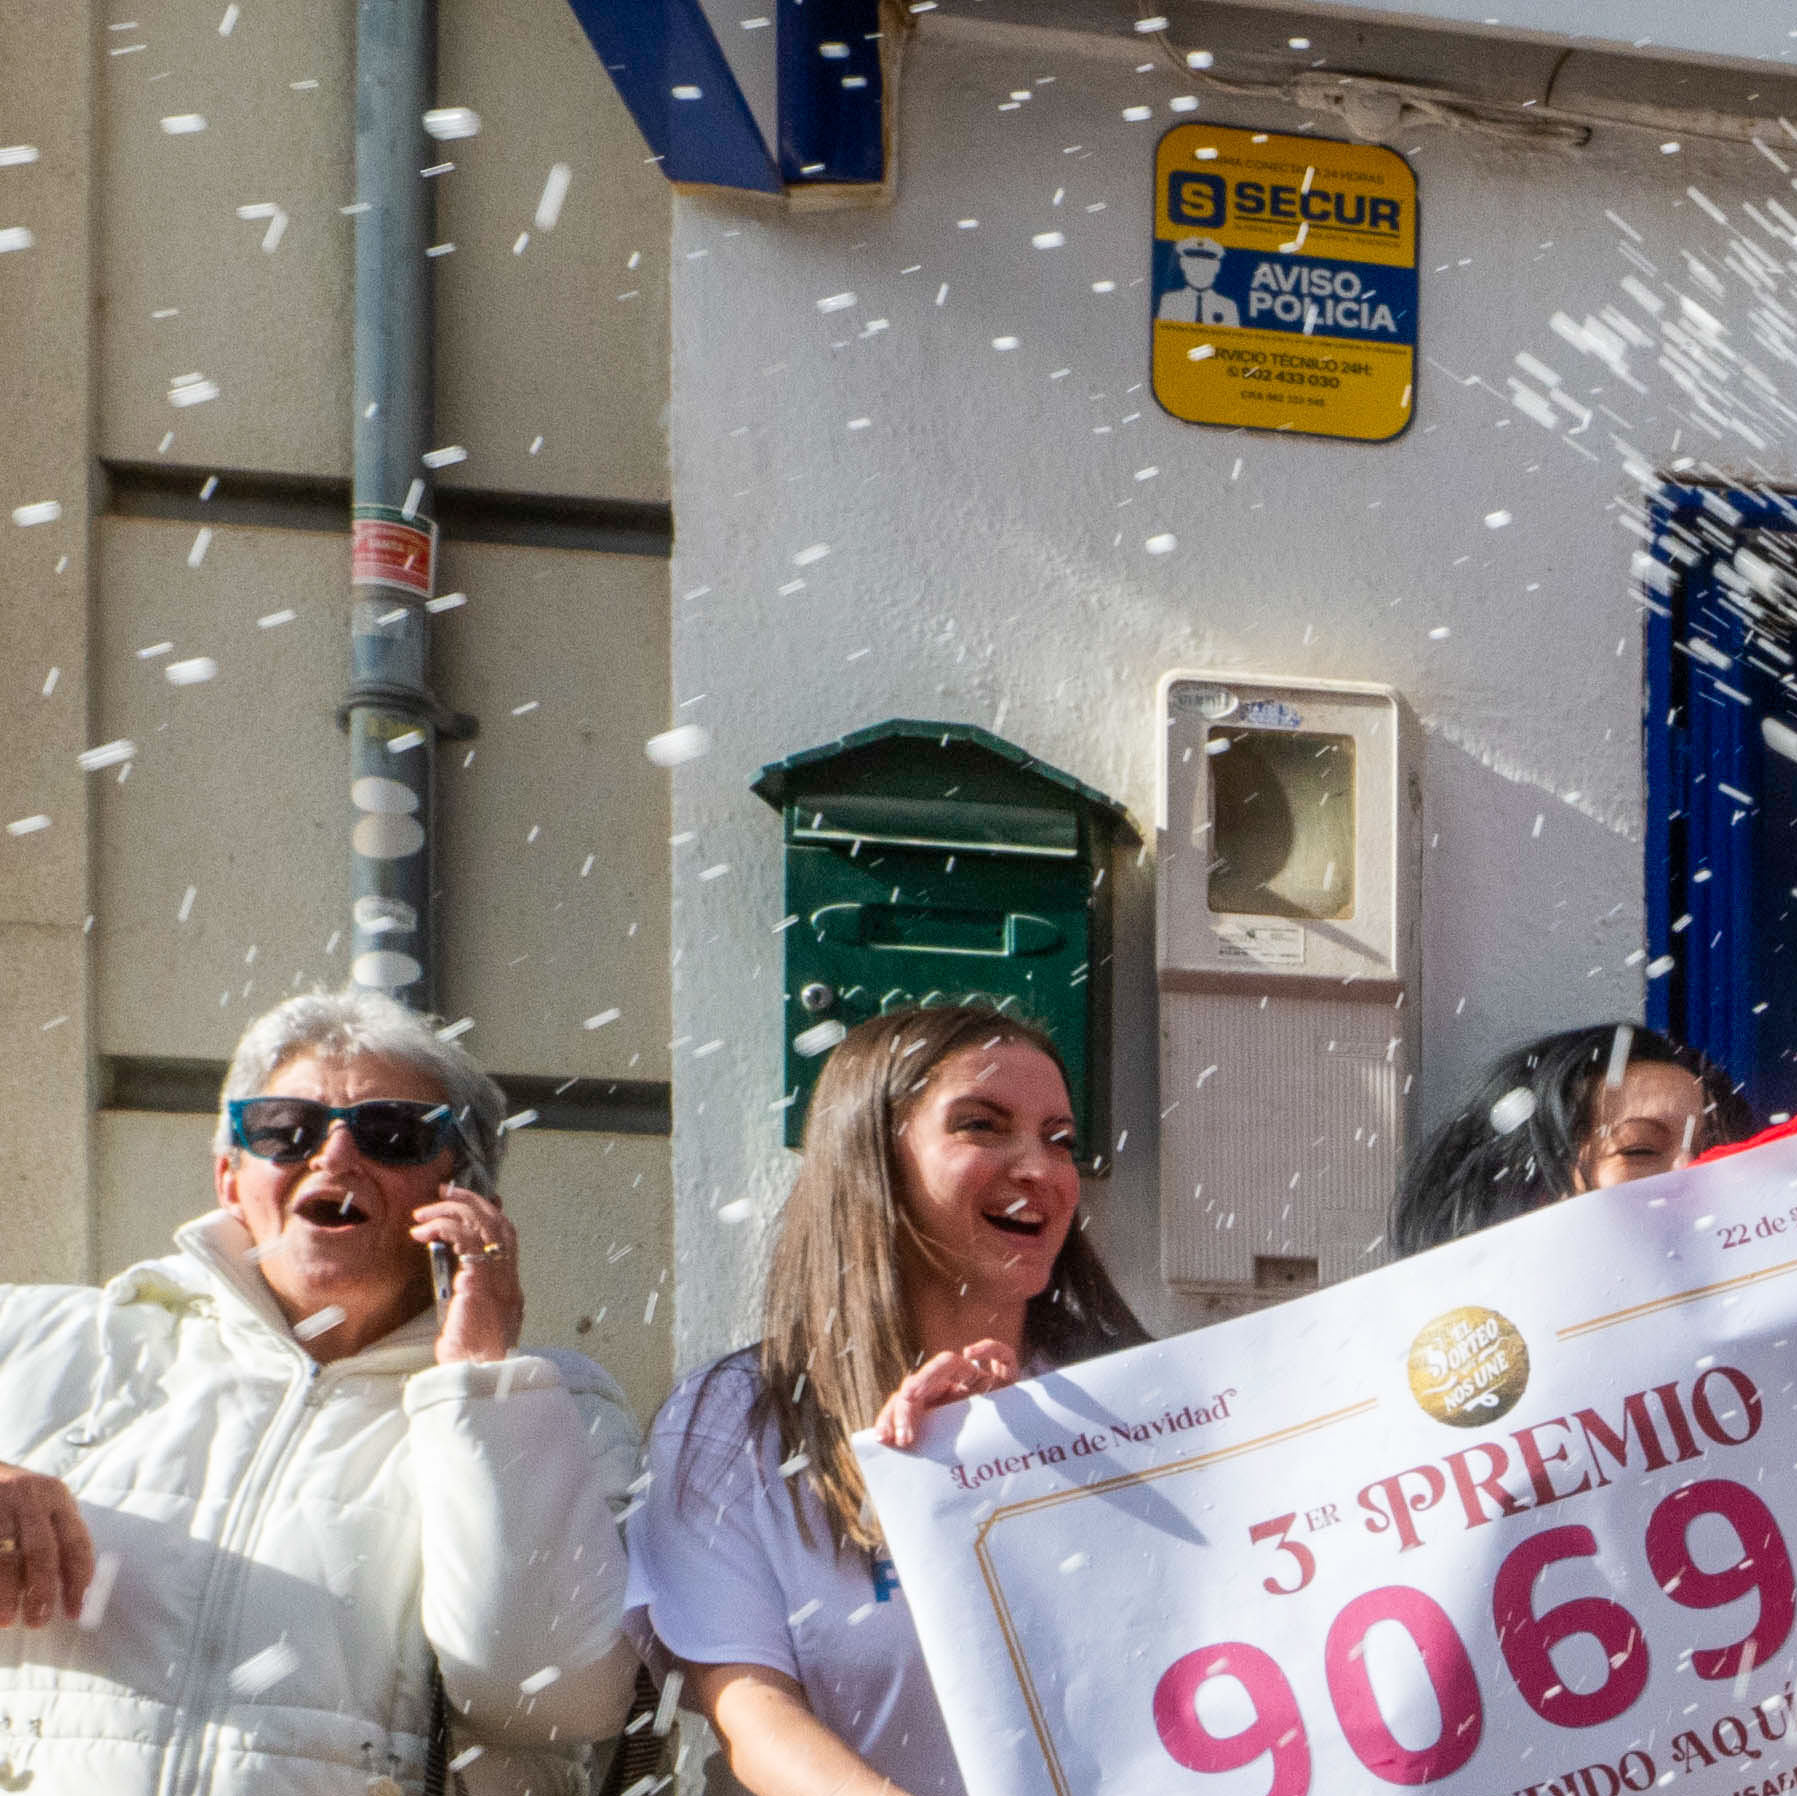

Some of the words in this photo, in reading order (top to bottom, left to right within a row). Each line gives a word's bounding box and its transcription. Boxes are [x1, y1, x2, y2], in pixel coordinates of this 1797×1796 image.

[1235, 181, 1400, 233] SECUR
[1251, 262, 1362, 299] AVISO
[1198, 345, 1267, 365] RVICIO
[1716, 1223, 1752, 1251] 22
[1755, 1212, 1788, 1240] de
[1443, 1378, 1475, 1412] NOS
[1473, 1350, 1509, 1389] UNE
[950, 1436, 1068, 1491] Lotería
[1072, 1428, 1107, 1459] de
[1110, 1388, 1241, 1450] Navidad
[1358, 1364, 1764, 1555] PREMIO
